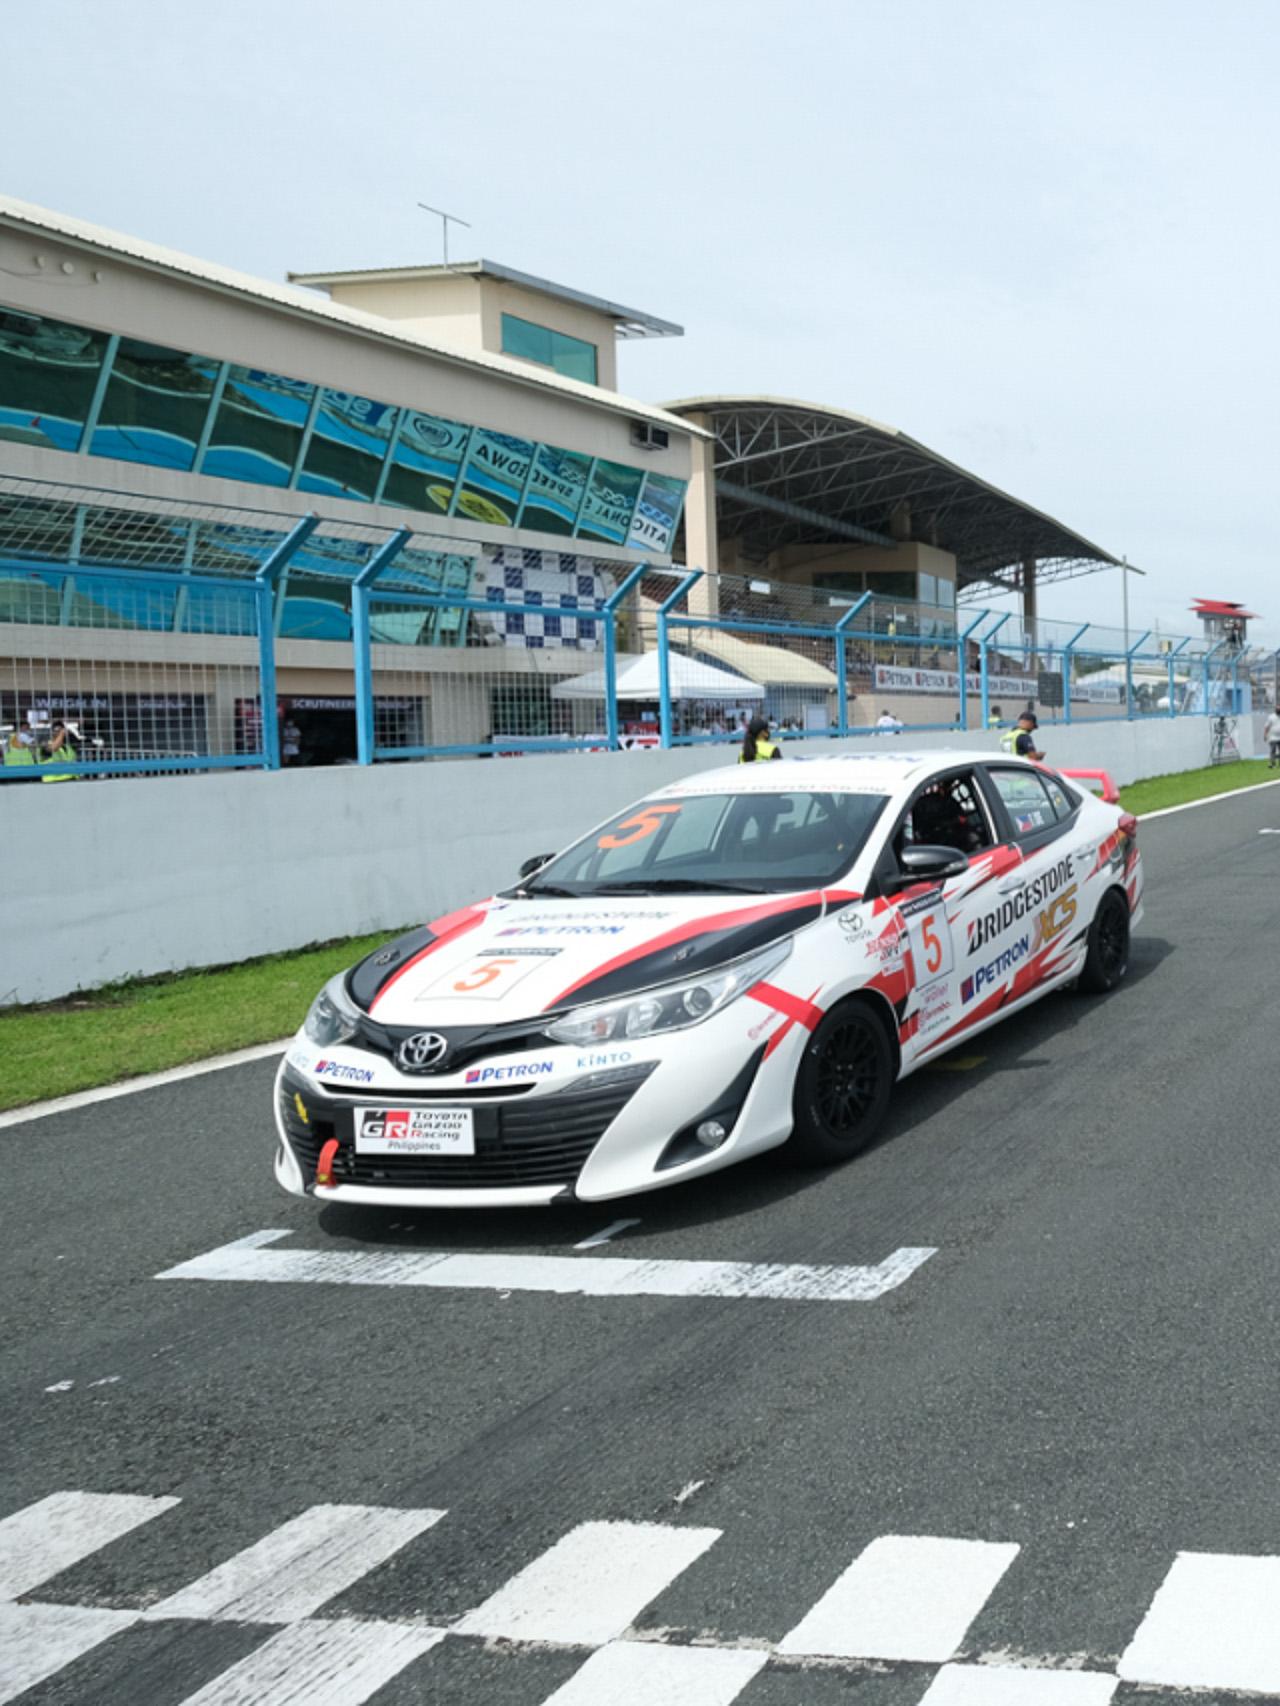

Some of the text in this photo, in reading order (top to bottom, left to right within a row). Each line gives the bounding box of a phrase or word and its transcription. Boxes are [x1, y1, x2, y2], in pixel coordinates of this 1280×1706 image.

[597, 804, 683, 850] 5
[967, 853, 1075, 957] BRIDGESTONE
[922, 914, 942, 973] 5
[975, 934, 1030, 993] PETRON
[453, 959, 517, 991] 5
[325, 1061, 375, 1083] PETRON
[480, 1061, 554, 1082] PETRON
[412, 1121, 462, 1129] GAZOO
[414, 1111, 468, 1120] TOYOTA
[361, 1120, 408, 1138] GR
[411, 1129, 460, 1142] Racing
[387, 1141, 441, 1152] Philippines
